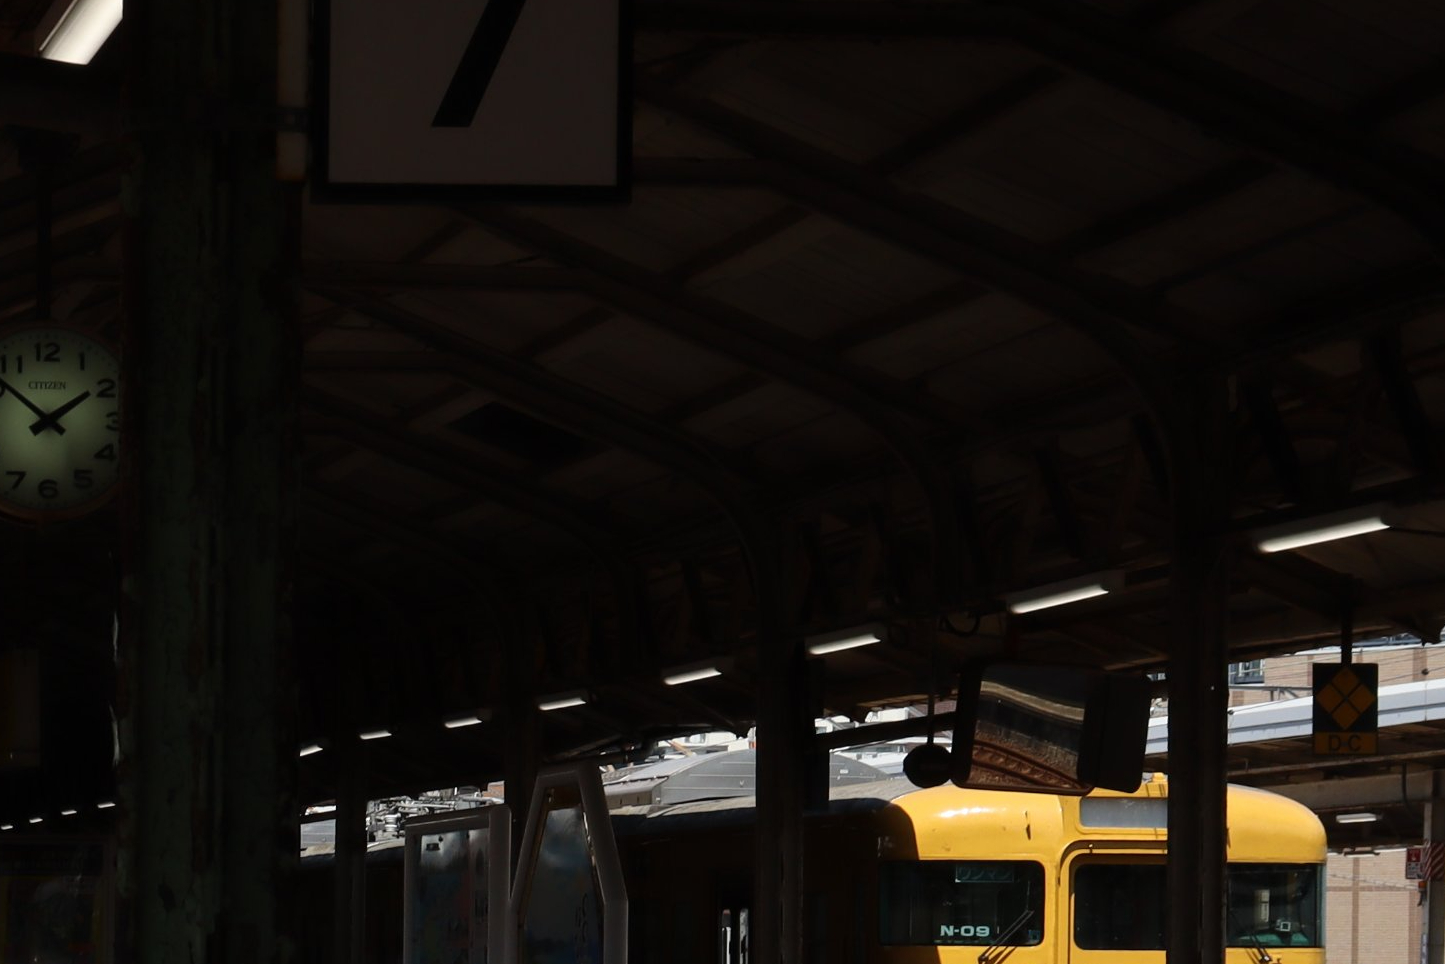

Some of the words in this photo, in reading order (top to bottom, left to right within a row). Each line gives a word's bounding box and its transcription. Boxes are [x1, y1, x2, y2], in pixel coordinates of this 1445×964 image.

[34, 342, 61, 362] 12
[78, 352, 86, 371] 1
[0, 354, 23, 374] 11
[28, 381, 67, 390] CITIZEN
[96, 378, 116, 398] 2
[93, 442, 116, 461] 4
[5, 470, 27, 489] 7
[37, 478, 58, 498] 6
[73, 469, 93, 488] 5
[940, 925, 990, 937] N-09
